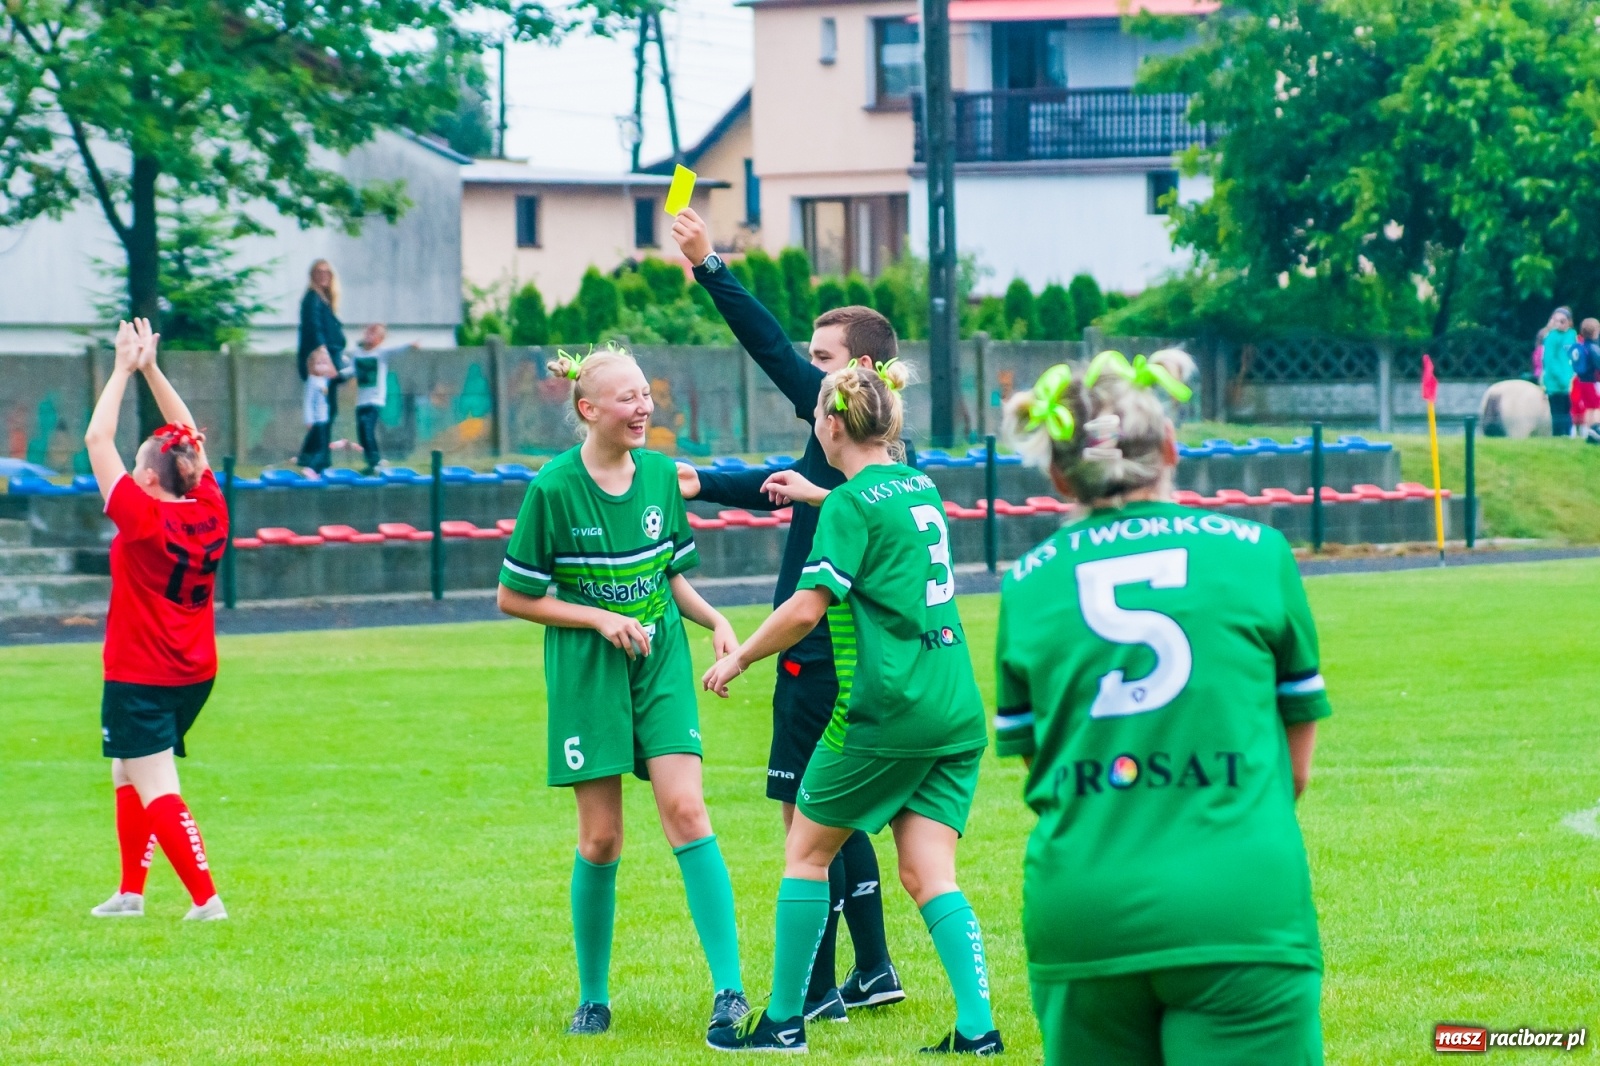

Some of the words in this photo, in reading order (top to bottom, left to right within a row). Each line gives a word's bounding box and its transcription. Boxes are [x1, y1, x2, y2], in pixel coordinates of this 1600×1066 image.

[860, 483, 893, 504] LKS
[580, 527, 603, 537] VIGO
[909, 504, 954, 608] 3
[1011, 539, 1058, 582] LKS
[1074, 547, 1193, 719] 5
[564, 735, 585, 771] 6
[1050, 751, 1247, 799] PROSAT
